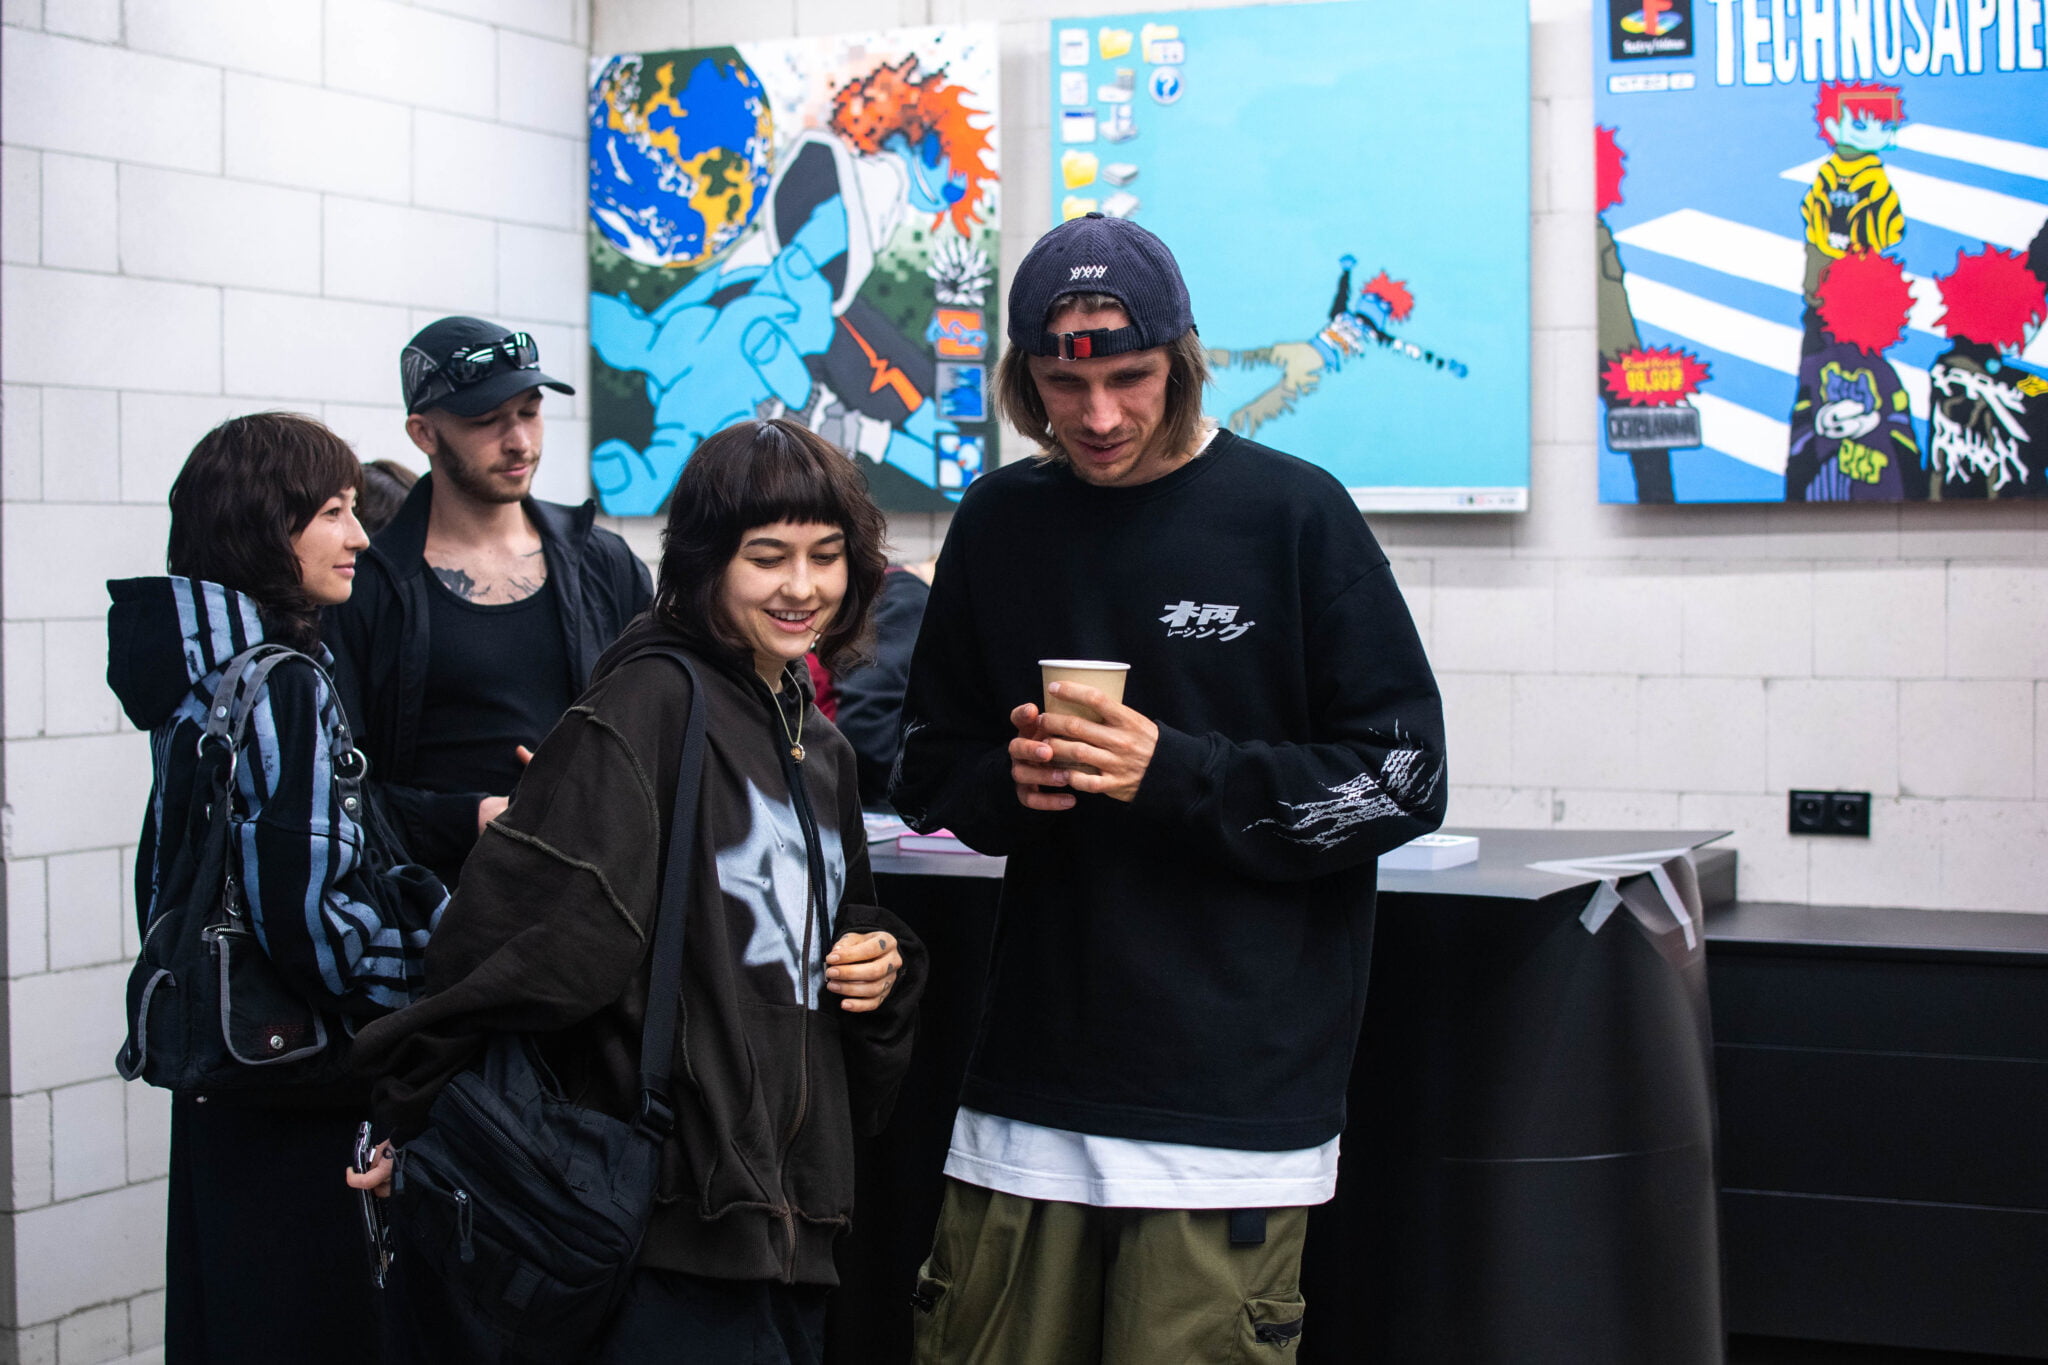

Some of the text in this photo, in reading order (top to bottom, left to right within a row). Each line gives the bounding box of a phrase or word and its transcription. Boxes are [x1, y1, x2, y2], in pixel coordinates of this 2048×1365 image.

[1707, 0, 2048, 86] TECHNOSAPIE
[1167, 620, 1256, 642] レーシング
